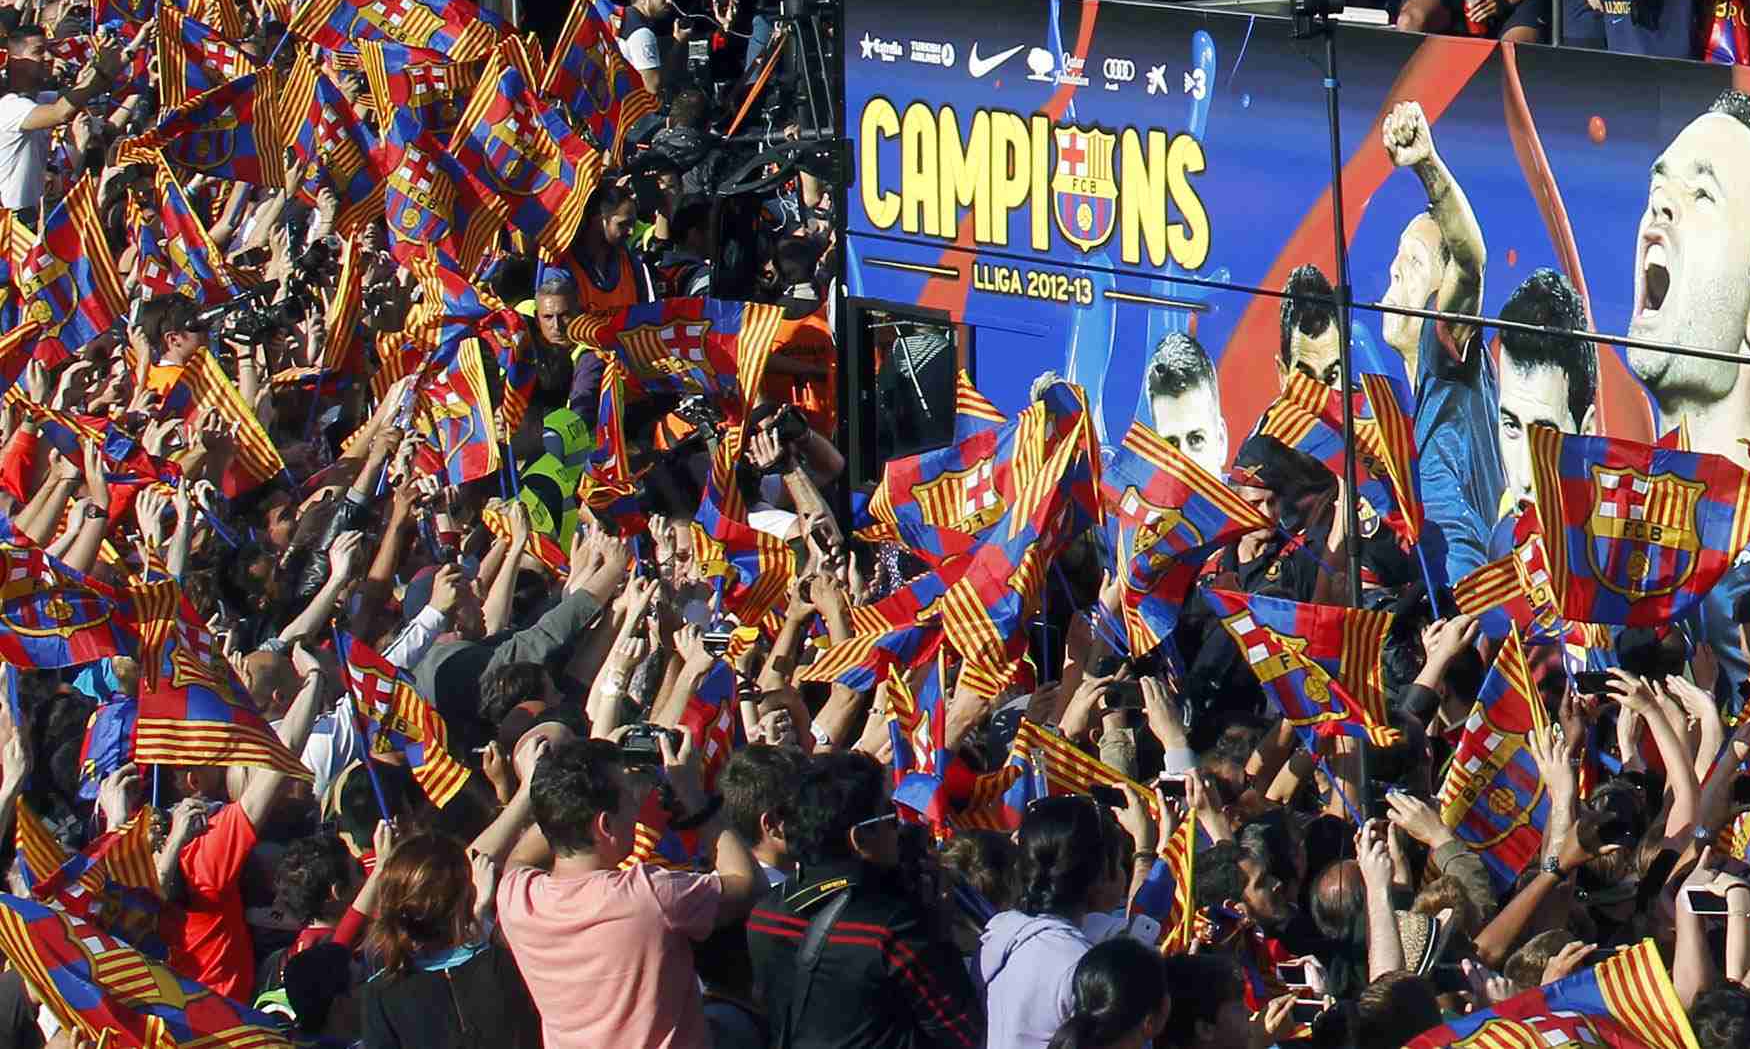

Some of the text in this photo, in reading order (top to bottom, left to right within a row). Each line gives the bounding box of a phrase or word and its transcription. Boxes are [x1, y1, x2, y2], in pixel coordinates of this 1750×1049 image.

[1072, 177, 1097, 195] FCB
[972, 264, 1094, 304] LLIGA 2012-13
[1623, 520, 1663, 542] FCB
